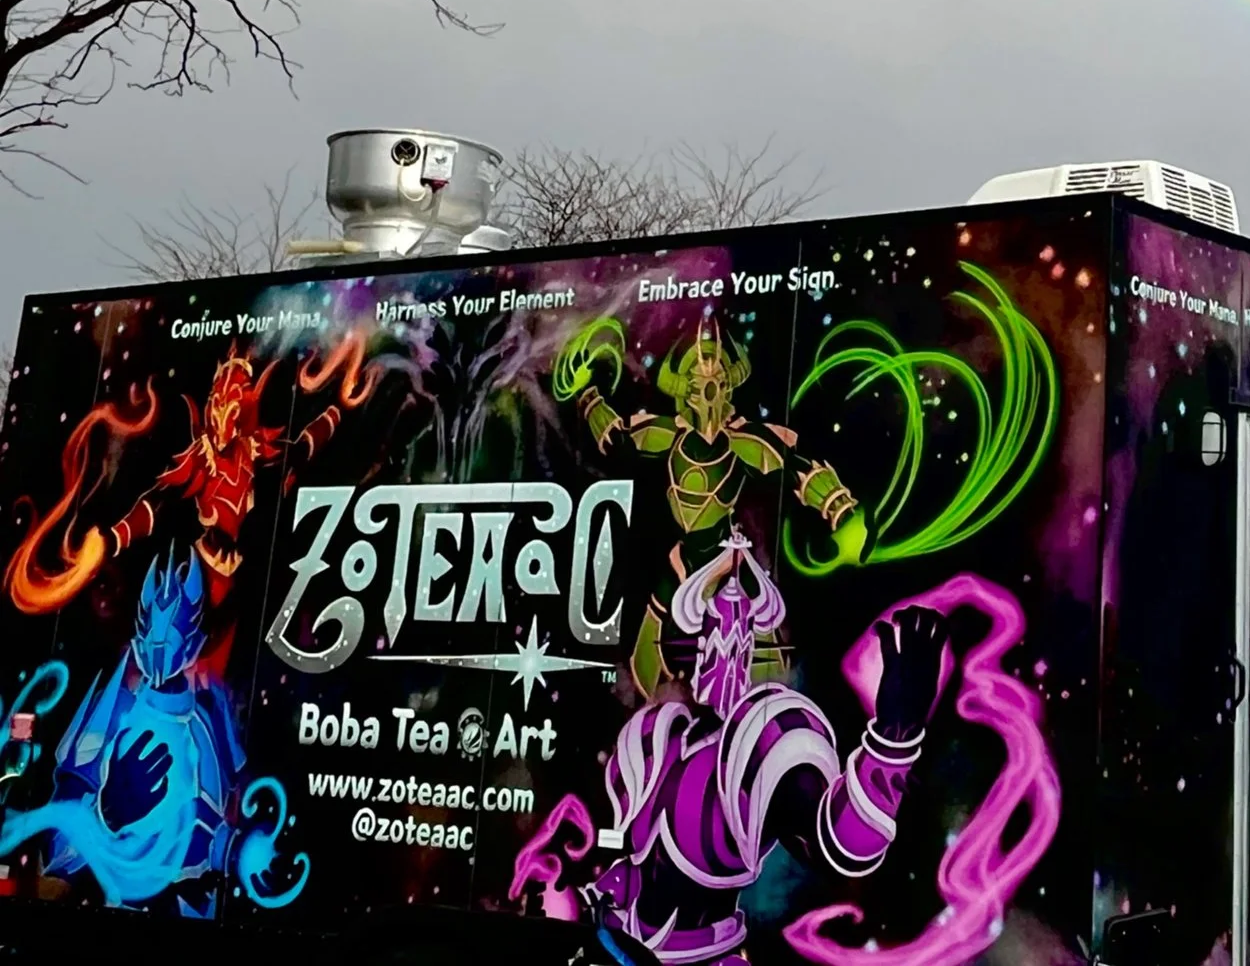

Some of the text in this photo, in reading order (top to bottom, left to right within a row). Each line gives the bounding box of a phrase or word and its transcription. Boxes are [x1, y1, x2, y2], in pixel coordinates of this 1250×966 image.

[638, 266, 839, 302] Embrace Your Sign.
[1130, 275, 1177, 307] Conjure
[1179, 289, 1207, 314] Your
[376, 287, 576, 322] Harness Your Element
[171, 315, 233, 342] Conjure
[236, 313, 276, 335] Your
[298, 701, 558, 762] Boba Tea Art
[308, 772, 535, 814] www.zoteaac.com
[351, 807, 474, 851] @zoteaac
